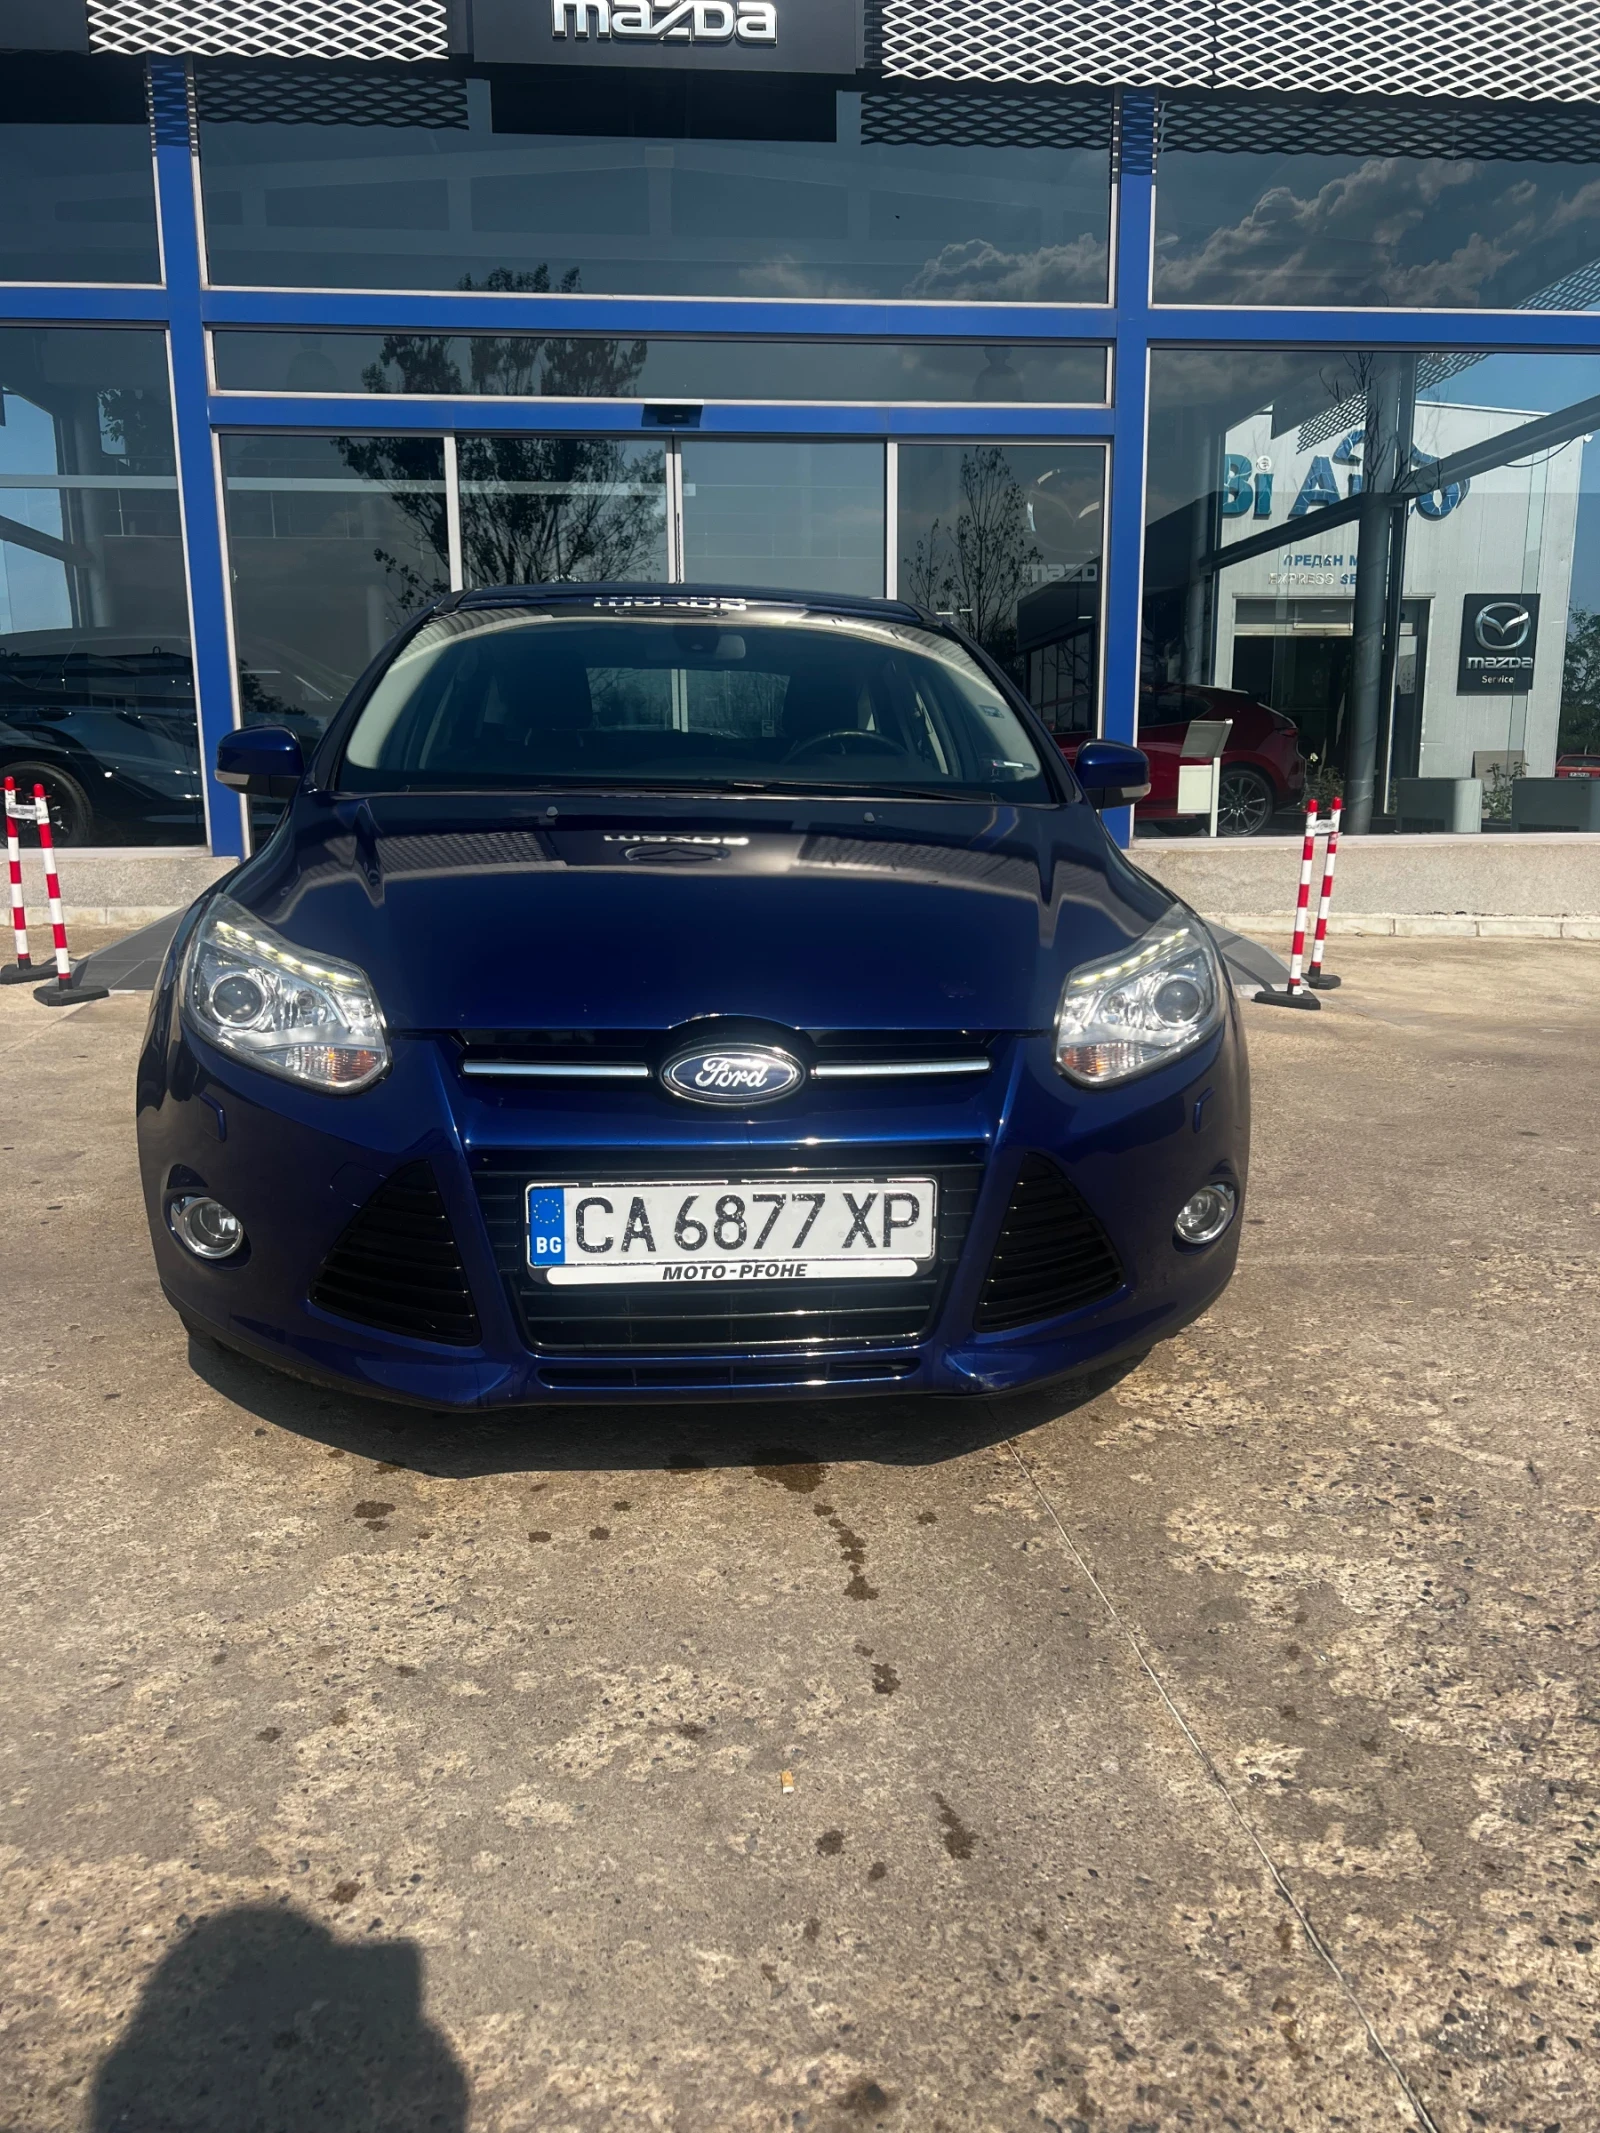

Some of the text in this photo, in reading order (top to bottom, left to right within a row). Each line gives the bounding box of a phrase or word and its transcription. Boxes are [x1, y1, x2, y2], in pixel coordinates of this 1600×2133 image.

[551, 0, 779, 45] mazda
[1268, 572, 1335, 585] EXPRESS
[1466, 656, 1534, 670] mazda
[1481, 674, 1515, 684] Service
[694, 1057, 768, 1088] Ford
[574, 1191, 921, 1254] CA 6877 XP
[535, 1236, 562, 1255] BG
[661, 1263, 808, 1281] MOTO-PFOHE
